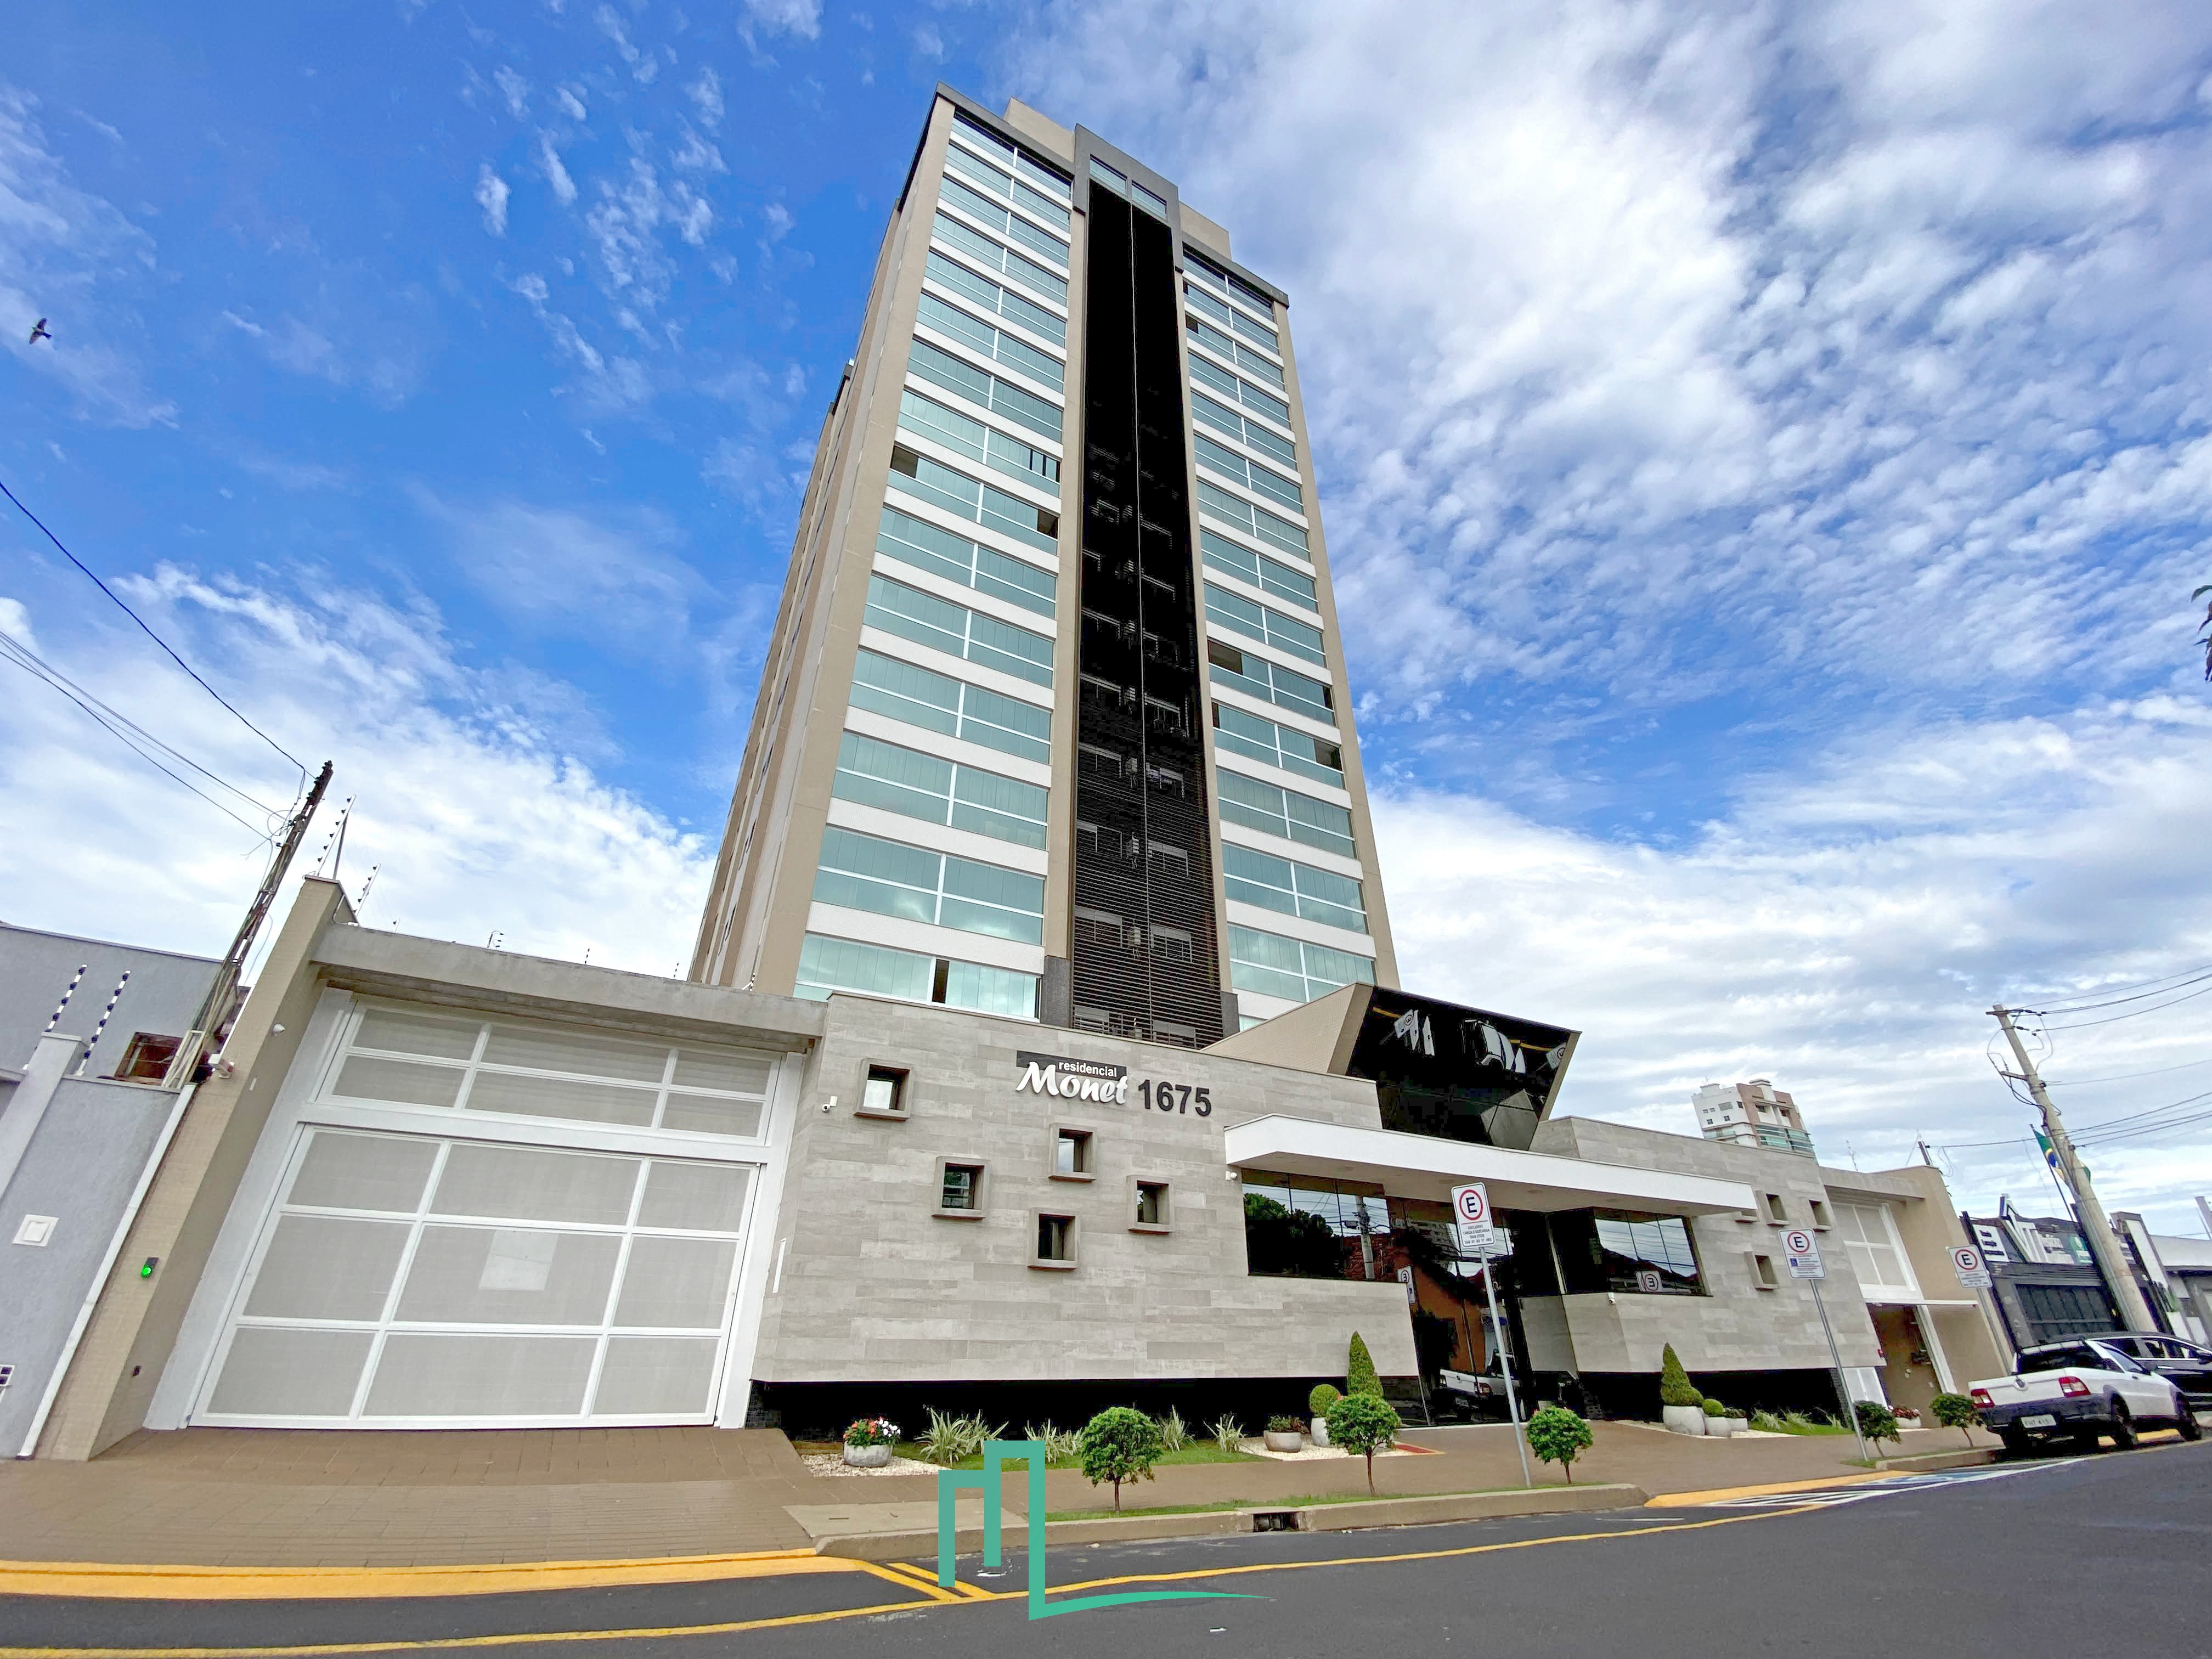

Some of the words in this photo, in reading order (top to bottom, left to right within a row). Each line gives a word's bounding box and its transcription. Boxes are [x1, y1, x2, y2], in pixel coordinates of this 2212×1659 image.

[1058, 1062, 1117, 1077] residencial
[1016, 1062, 1128, 1105] Monet
[1138, 1079, 1212, 1117] 1675
[1466, 1197, 1477, 1213] E
[1793, 1237, 1804, 1248] E
[1960, 1254, 1973, 1265] E
